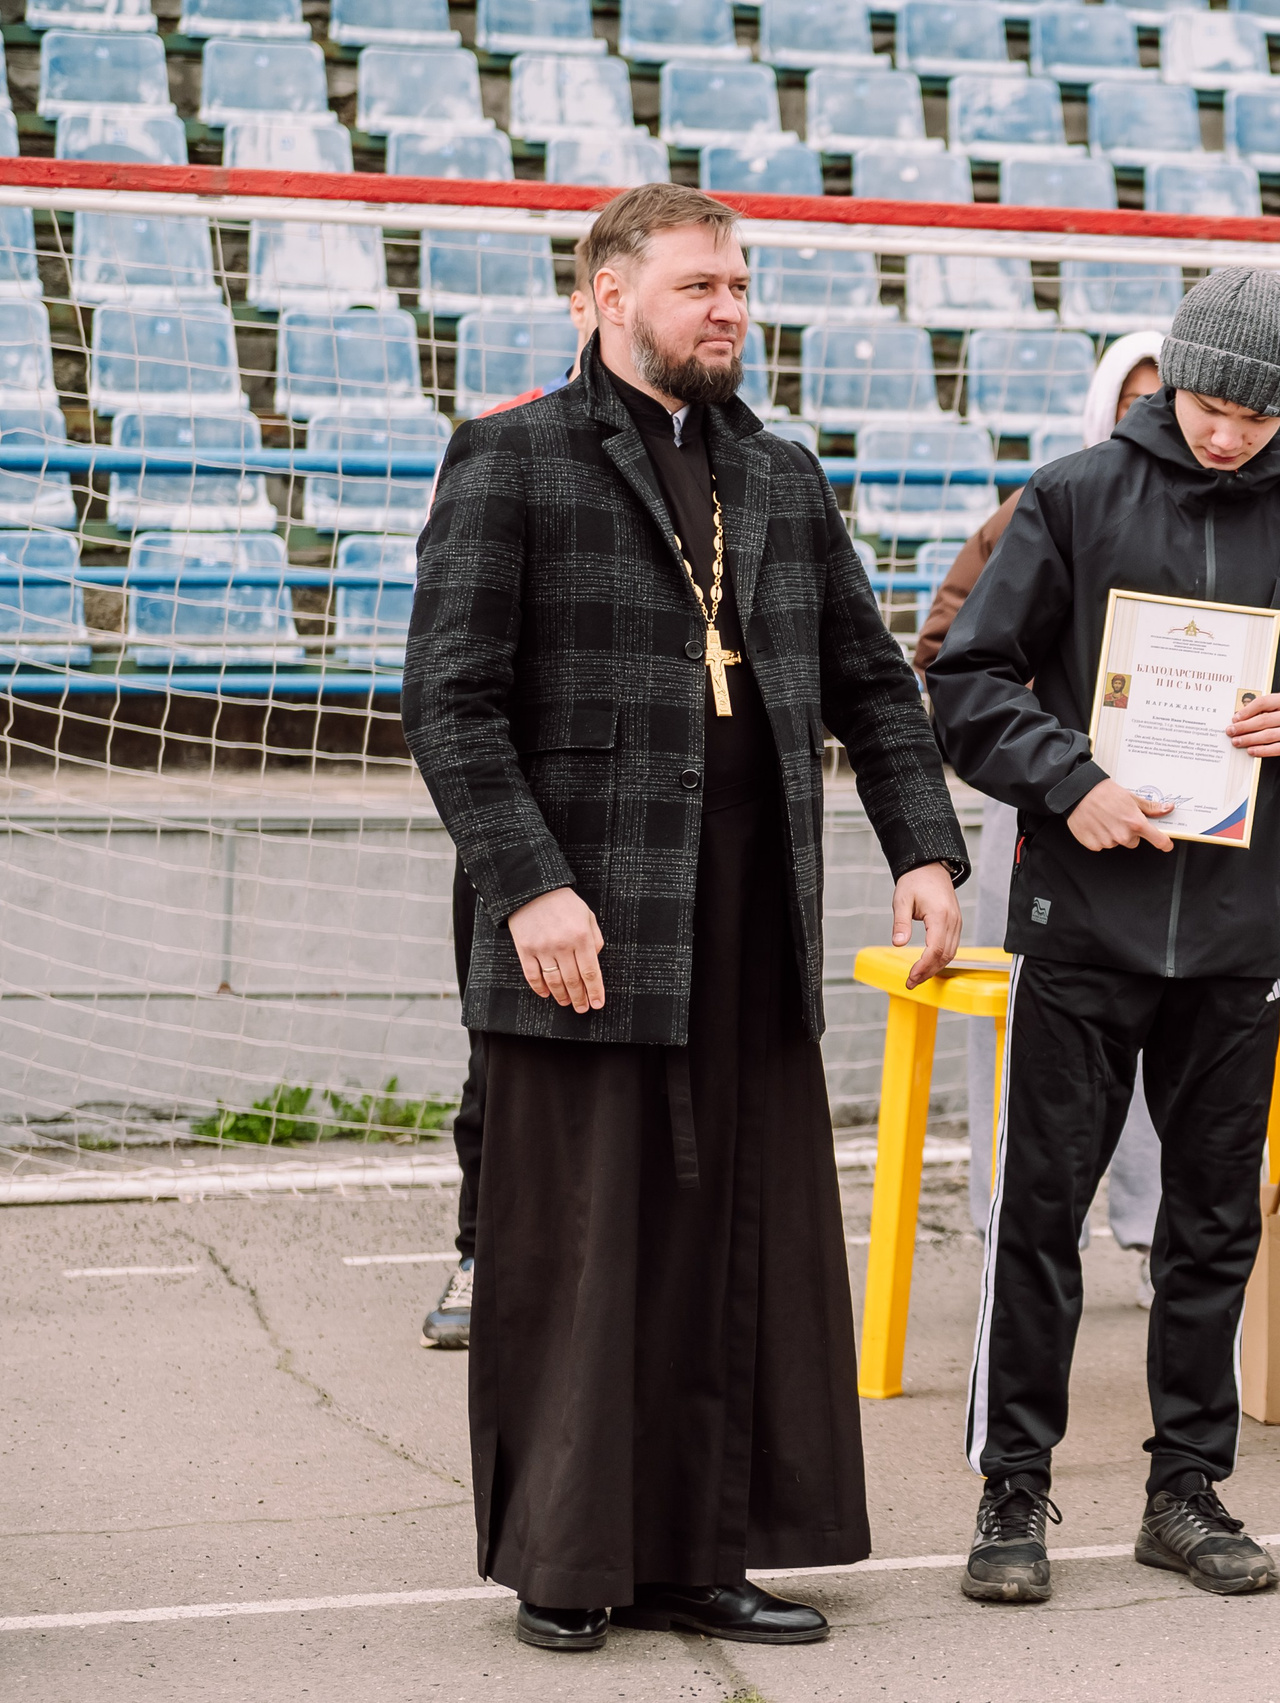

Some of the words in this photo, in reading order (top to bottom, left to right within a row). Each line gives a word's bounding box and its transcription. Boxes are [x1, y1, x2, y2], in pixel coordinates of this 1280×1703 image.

[1137, 664, 1234, 684] БЛАГОДАРСТВЕННОЕ
[1156, 678, 1212, 692] ПИСЬМО
[1146, 700, 1217, 713] НАГРАЖДАЕТСЯ
